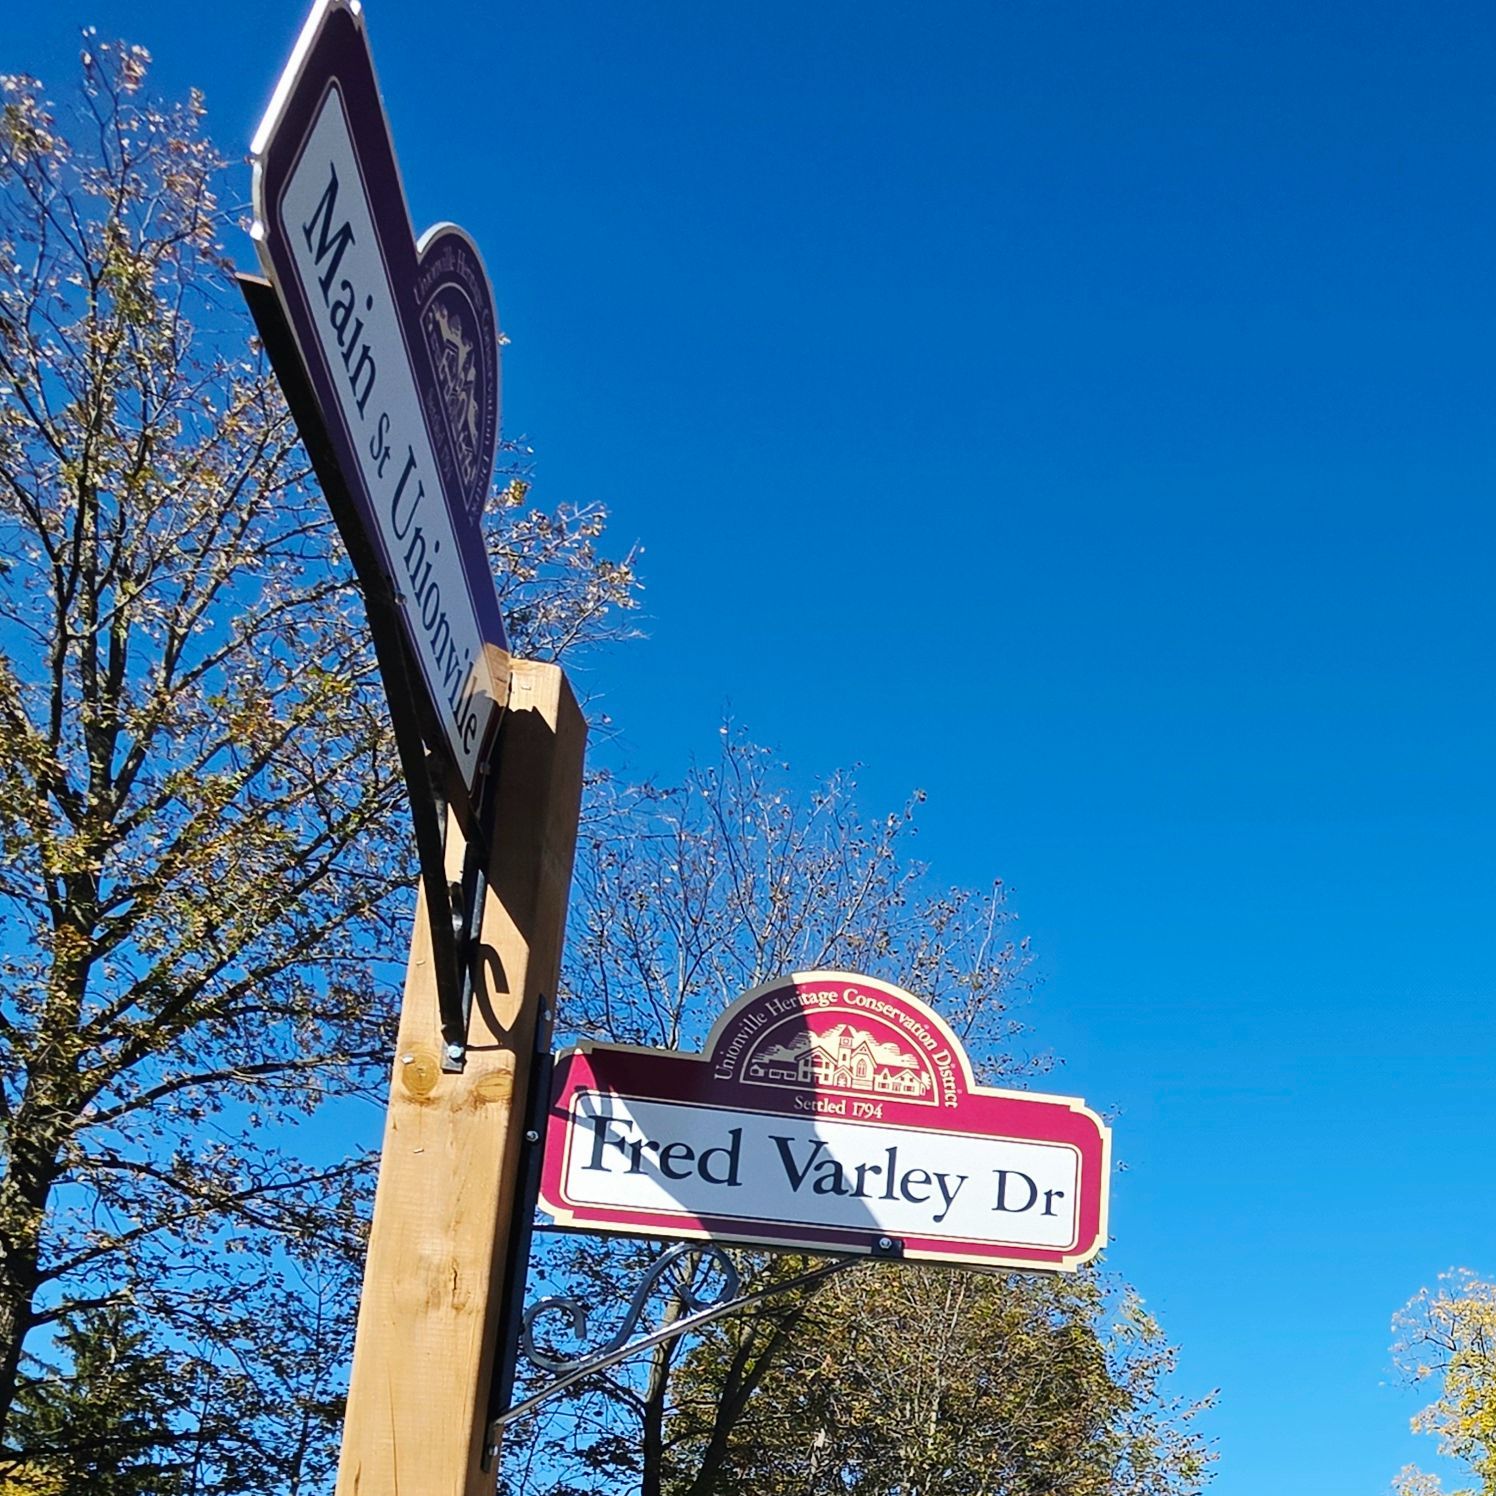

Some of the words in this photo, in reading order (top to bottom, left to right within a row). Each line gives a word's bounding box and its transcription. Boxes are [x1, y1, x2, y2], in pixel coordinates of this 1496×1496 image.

[303, 160, 377, 421] Main
[369, 412, 392, 479] St
[391, 444, 477, 755] Unionville
[713, 1010, 768, 1081] Unionville
[765, 986, 839, 1017] Heritage
[843, 988, 938, 1052] Conservation
[933, 1048, 963, 1109] District
[794, 1096, 846, 1115] Settled
[852, 1103, 883, 1119] 1794
[579, 1113, 744, 1188] Fred
[768, 1135, 969, 1223] Varley
[991, 1169, 1065, 1218] Dr
